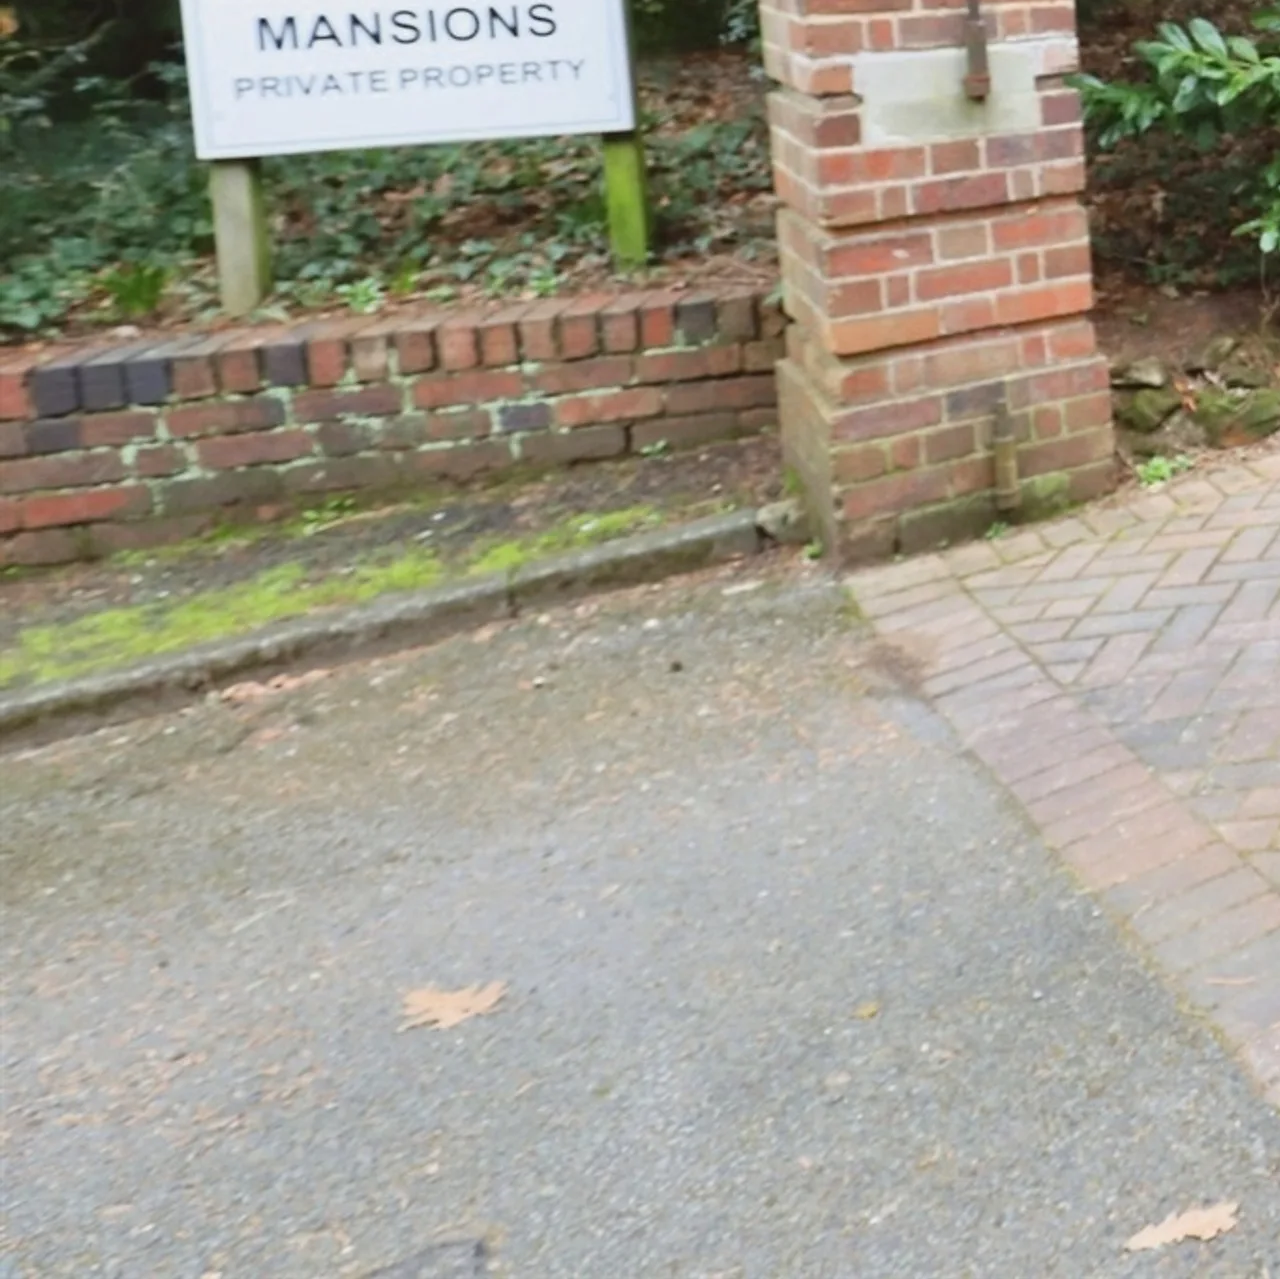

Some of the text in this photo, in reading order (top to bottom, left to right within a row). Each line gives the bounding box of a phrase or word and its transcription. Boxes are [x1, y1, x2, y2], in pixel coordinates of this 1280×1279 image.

[257, 2, 557, 51] MANSIONS
[234, 59, 586, 100] PRIVATE PROPERTY
